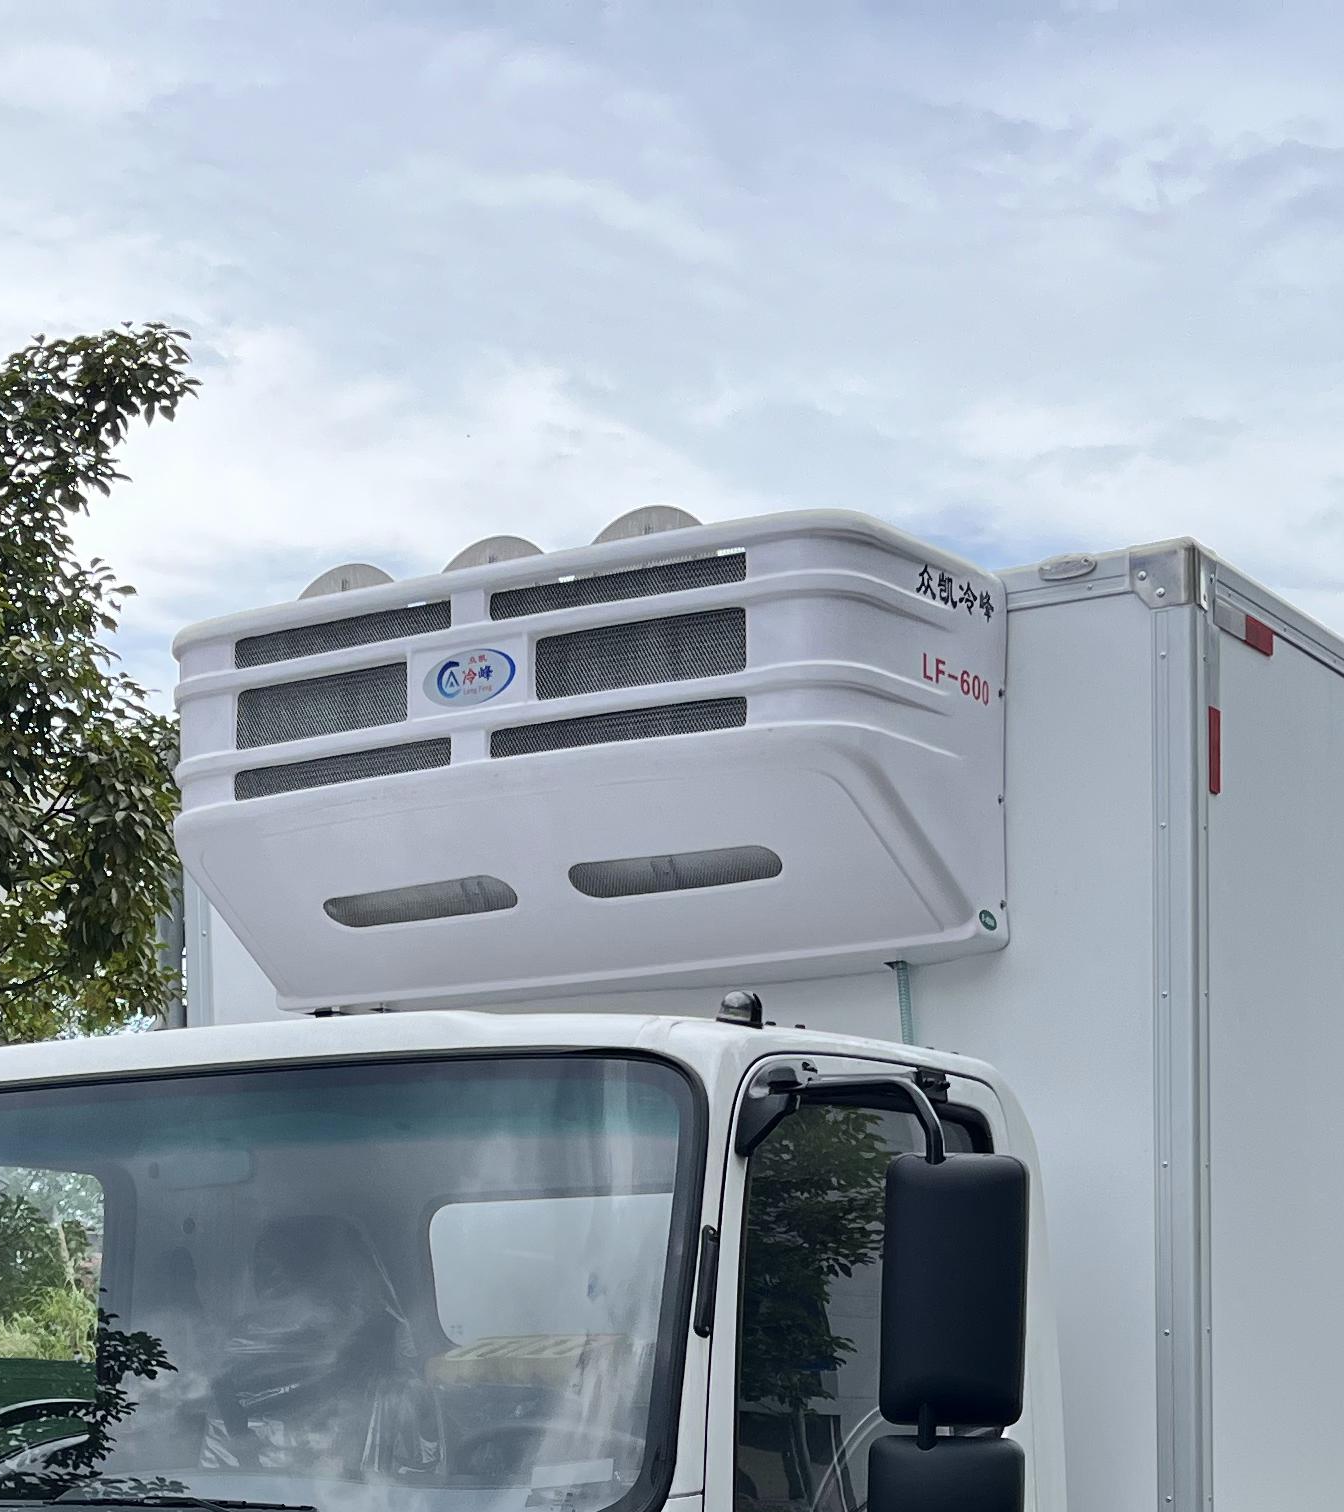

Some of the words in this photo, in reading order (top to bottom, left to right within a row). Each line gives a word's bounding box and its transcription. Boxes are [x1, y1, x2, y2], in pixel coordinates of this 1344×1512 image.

[916, 563, 995, 623] 众凯冷峰
[462, 665, 494, 685] 冷峰
[923, 652, 990, 706] LF-600
